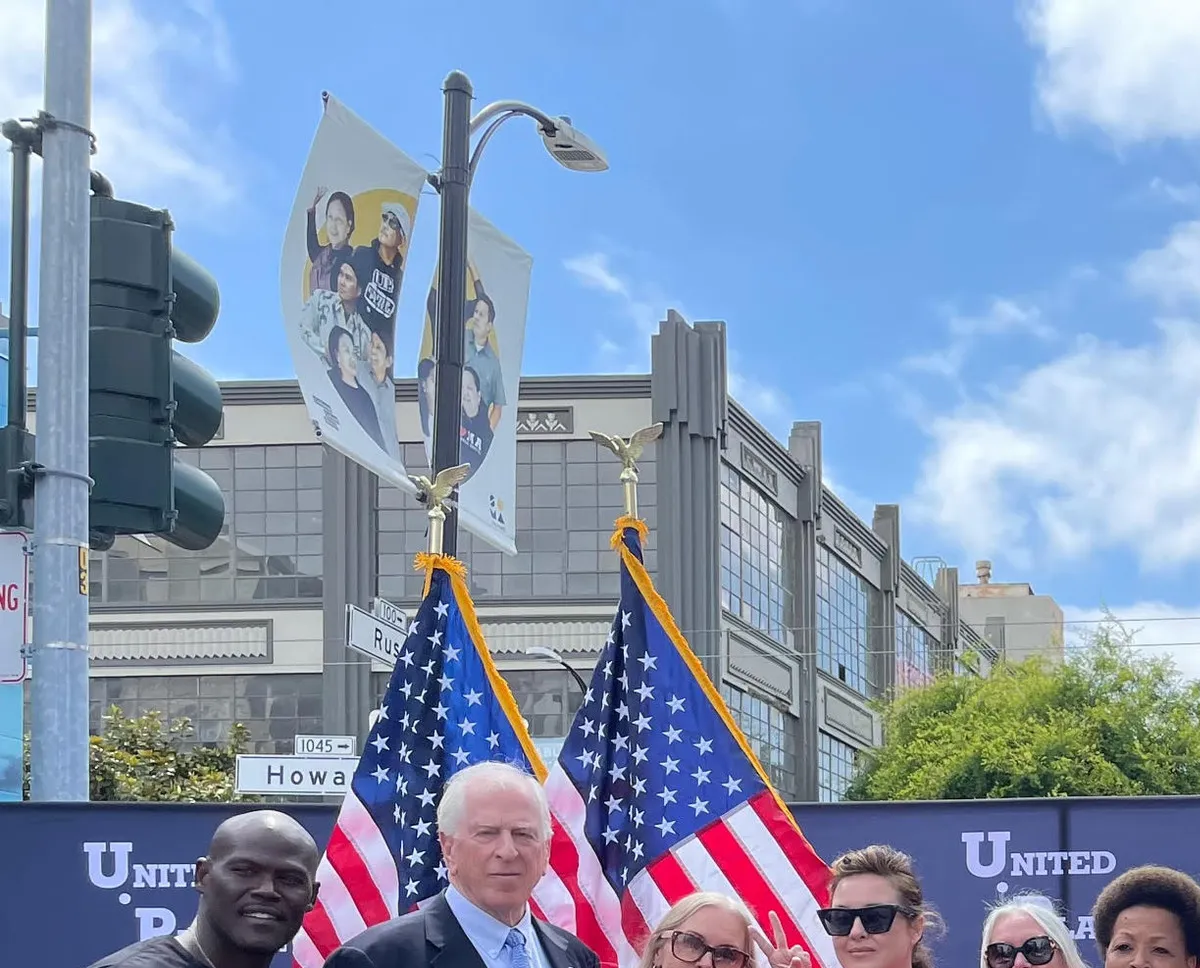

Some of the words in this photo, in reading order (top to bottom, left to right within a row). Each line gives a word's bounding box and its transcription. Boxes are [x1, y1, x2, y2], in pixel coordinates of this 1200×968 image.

[374, 628, 401, 659] Rus
[301, 738, 333, 753] 1045
[267, 764, 349, 786] Howa
[83, 842, 198, 889] UNIT
[960, 831, 1117, 878] UNITED
